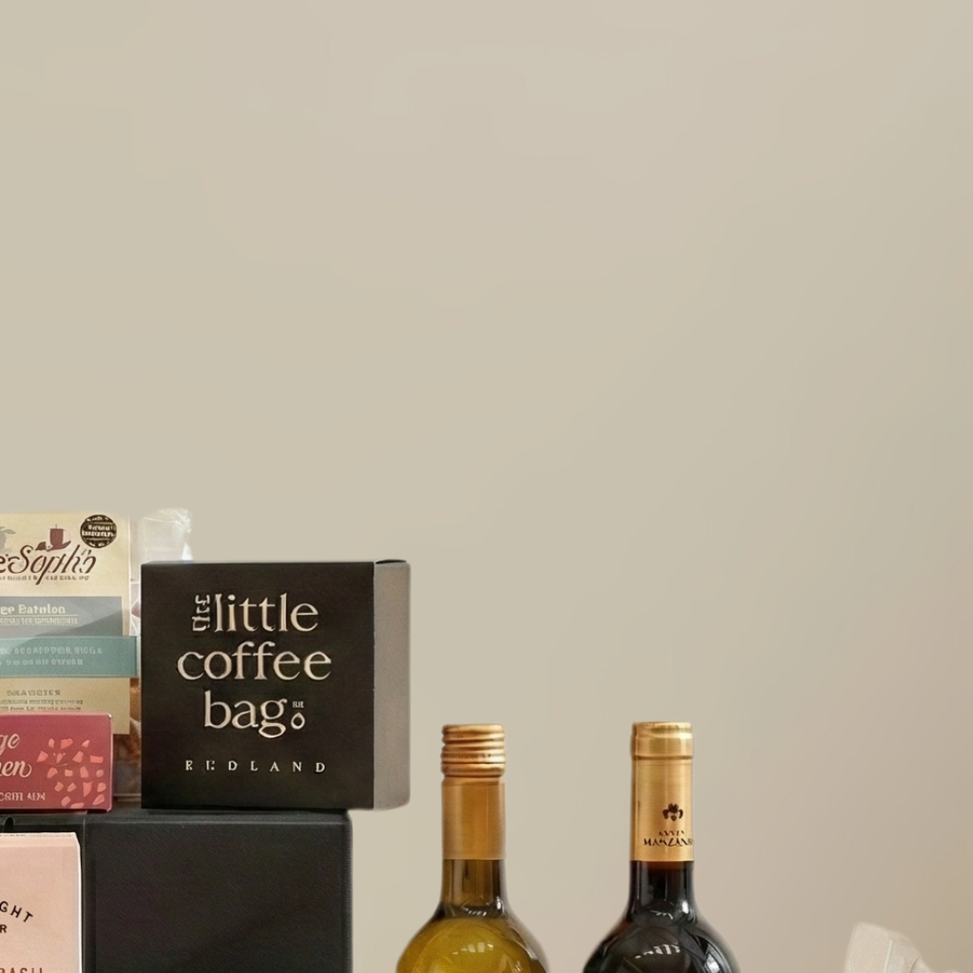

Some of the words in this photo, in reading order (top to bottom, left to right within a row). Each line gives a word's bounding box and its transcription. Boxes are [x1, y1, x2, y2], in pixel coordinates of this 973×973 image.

[214, 592, 319, 633] little
[177, 640, 333, 681] coffee
[203, 689, 288, 739] bag
